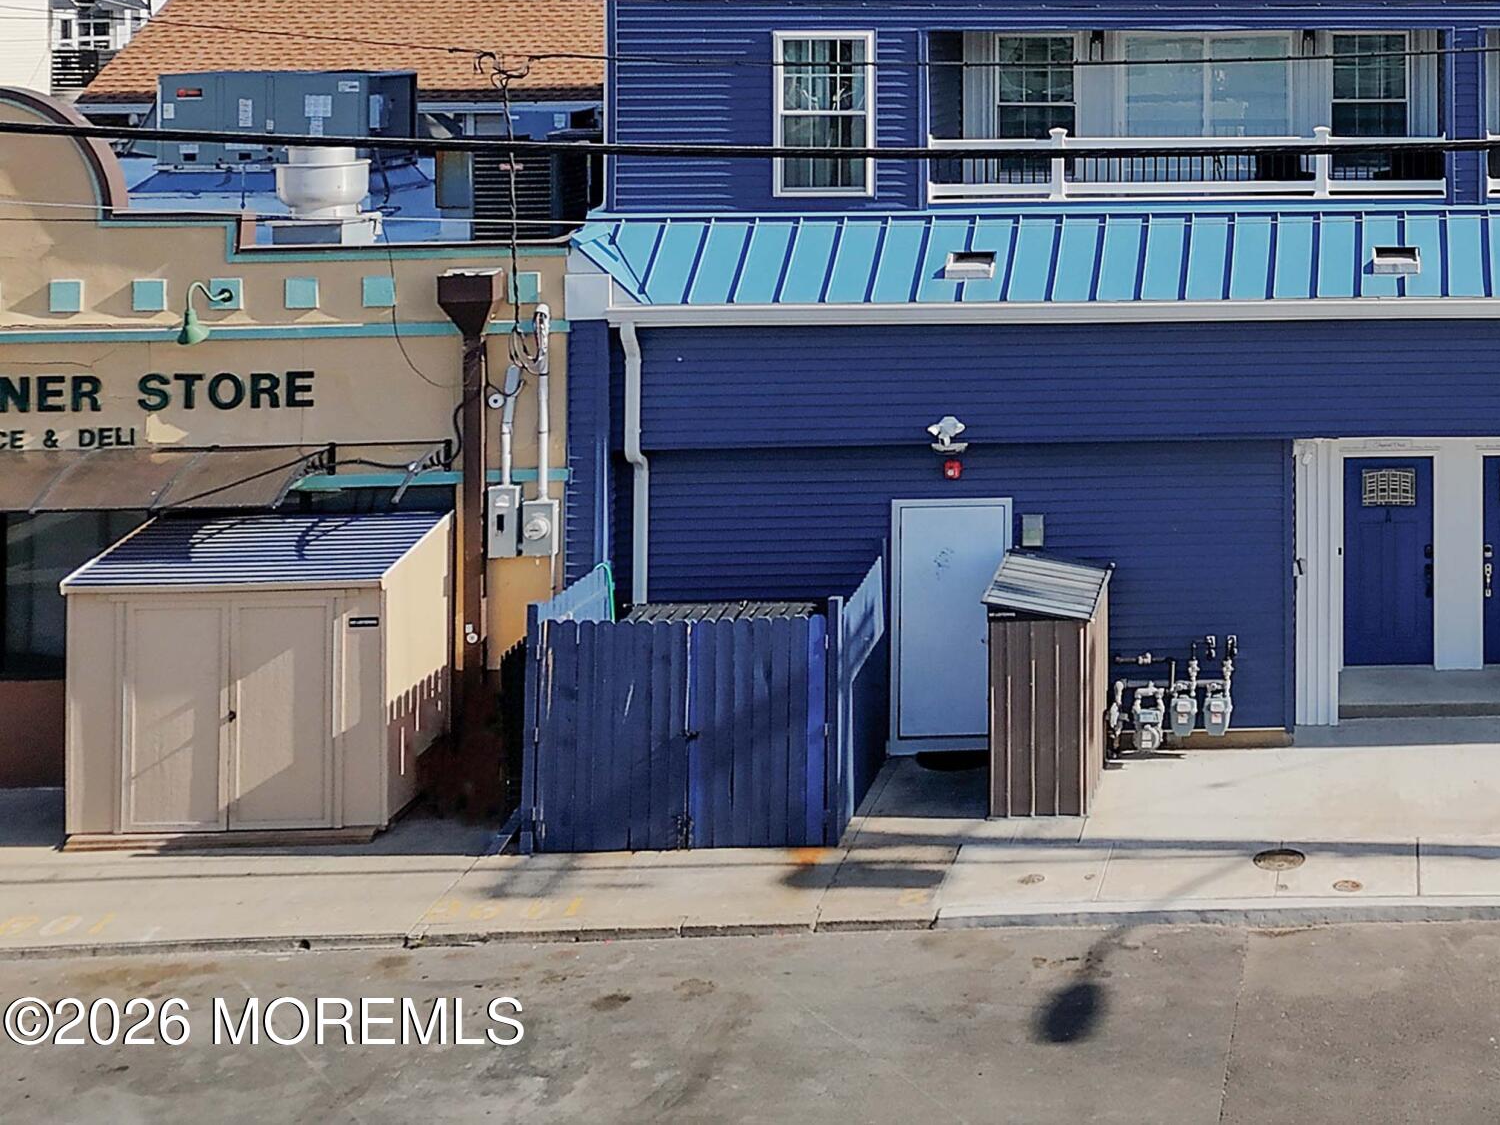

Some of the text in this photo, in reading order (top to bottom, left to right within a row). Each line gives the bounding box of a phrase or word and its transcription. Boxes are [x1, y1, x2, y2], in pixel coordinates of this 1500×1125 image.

[0, 371, 315, 413] NER STORE
[42, 429, 59, 449] &
[78, 426, 136, 449] DELI
